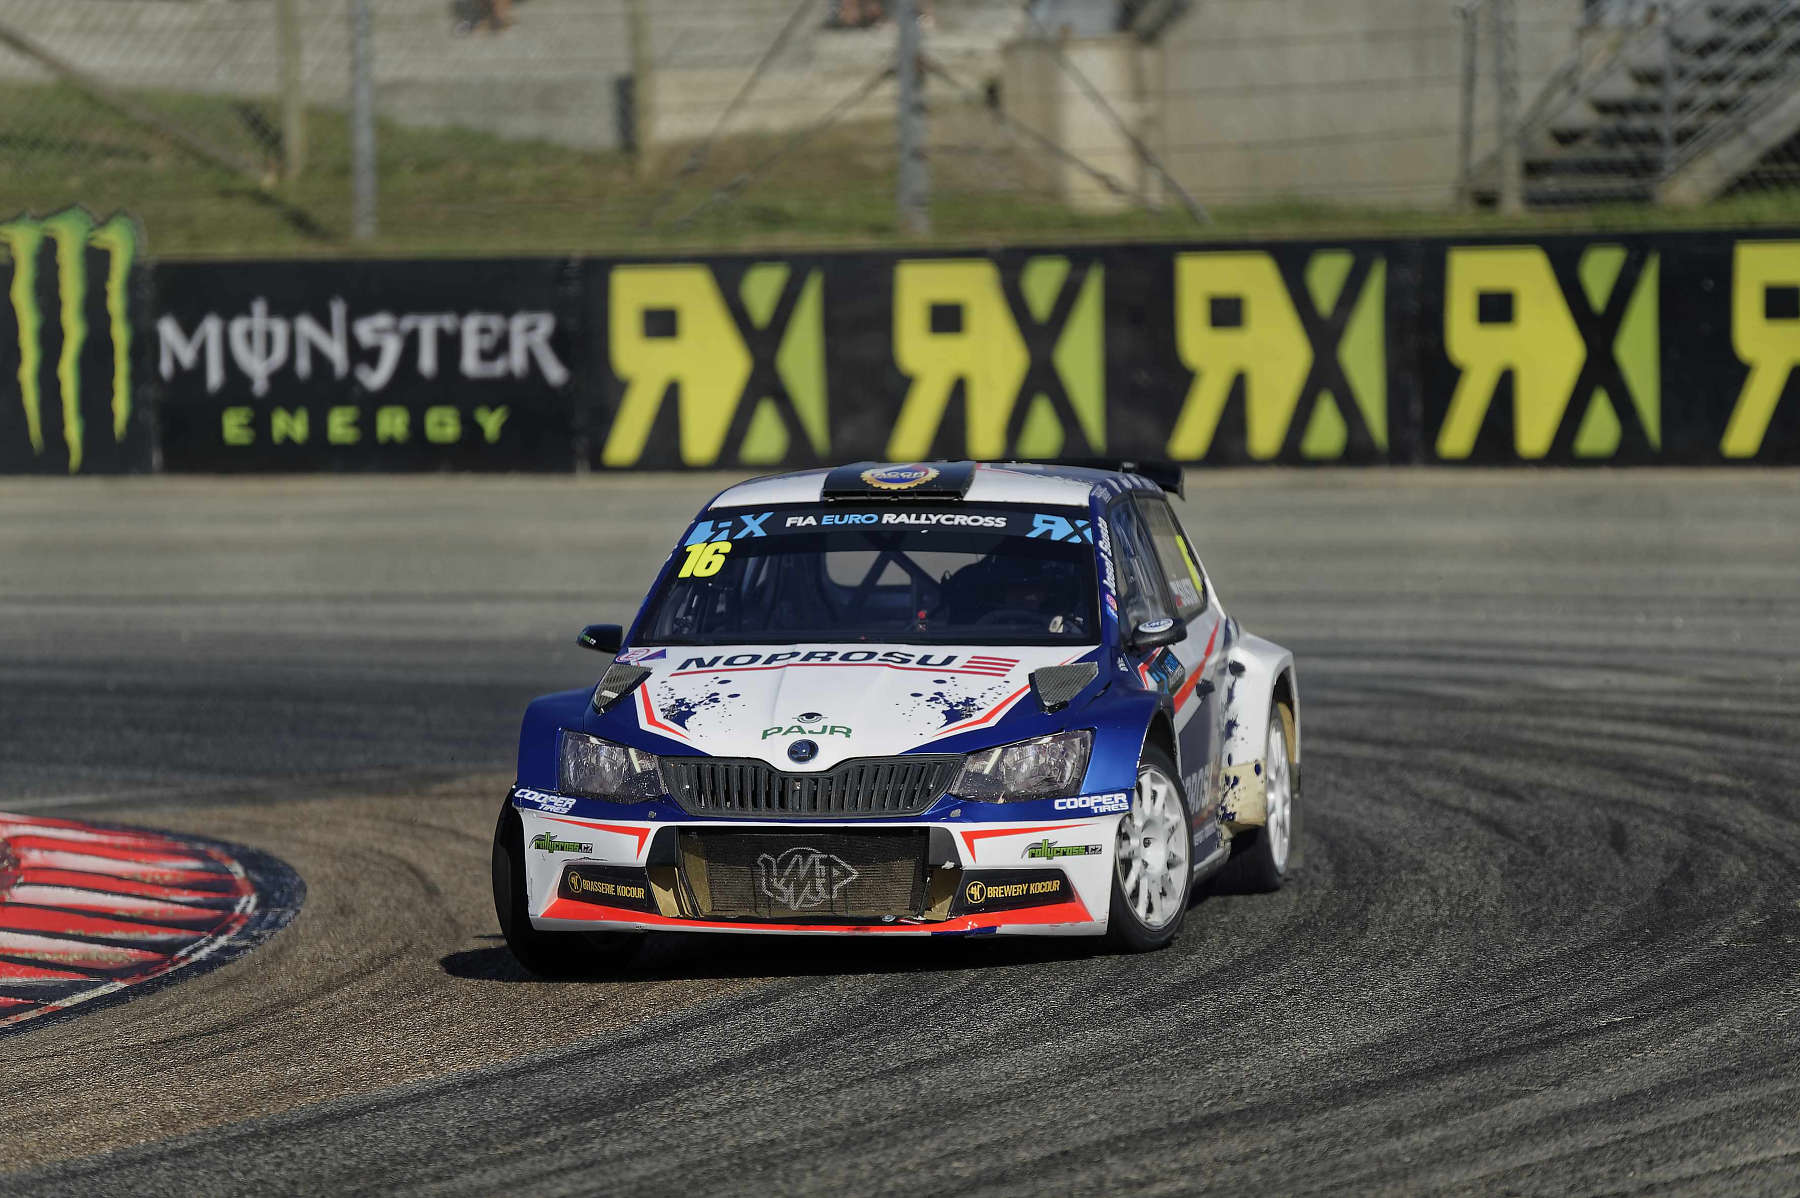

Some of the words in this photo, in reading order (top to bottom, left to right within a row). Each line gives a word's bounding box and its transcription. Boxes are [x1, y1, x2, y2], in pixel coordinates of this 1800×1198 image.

[157, 296, 569, 396] MONSTER
[221, 405, 509, 445] ENERGY
[785, 516, 817, 528] FIA
[821, 513, 878, 526] EURO
[882, 513, 1007, 528] RALLYCROSS
[678, 541, 732, 578] 16
[677, 651, 958, 671] NOPROSU
[761, 725, 853, 741] PAJR
[514, 788, 577, 808] COOPER
[1054, 793, 1128, 810] COOPER
[1091, 802, 1129, 813] TIRES
[538, 803, 571, 814] TIRES
[582, 879, 616, 896] BRASSERIE
[617, 885, 645, 899] KOCOUR
[987, 884, 1028, 898] BREWERY
[1030, 880, 1060, 895] KOCOUR
